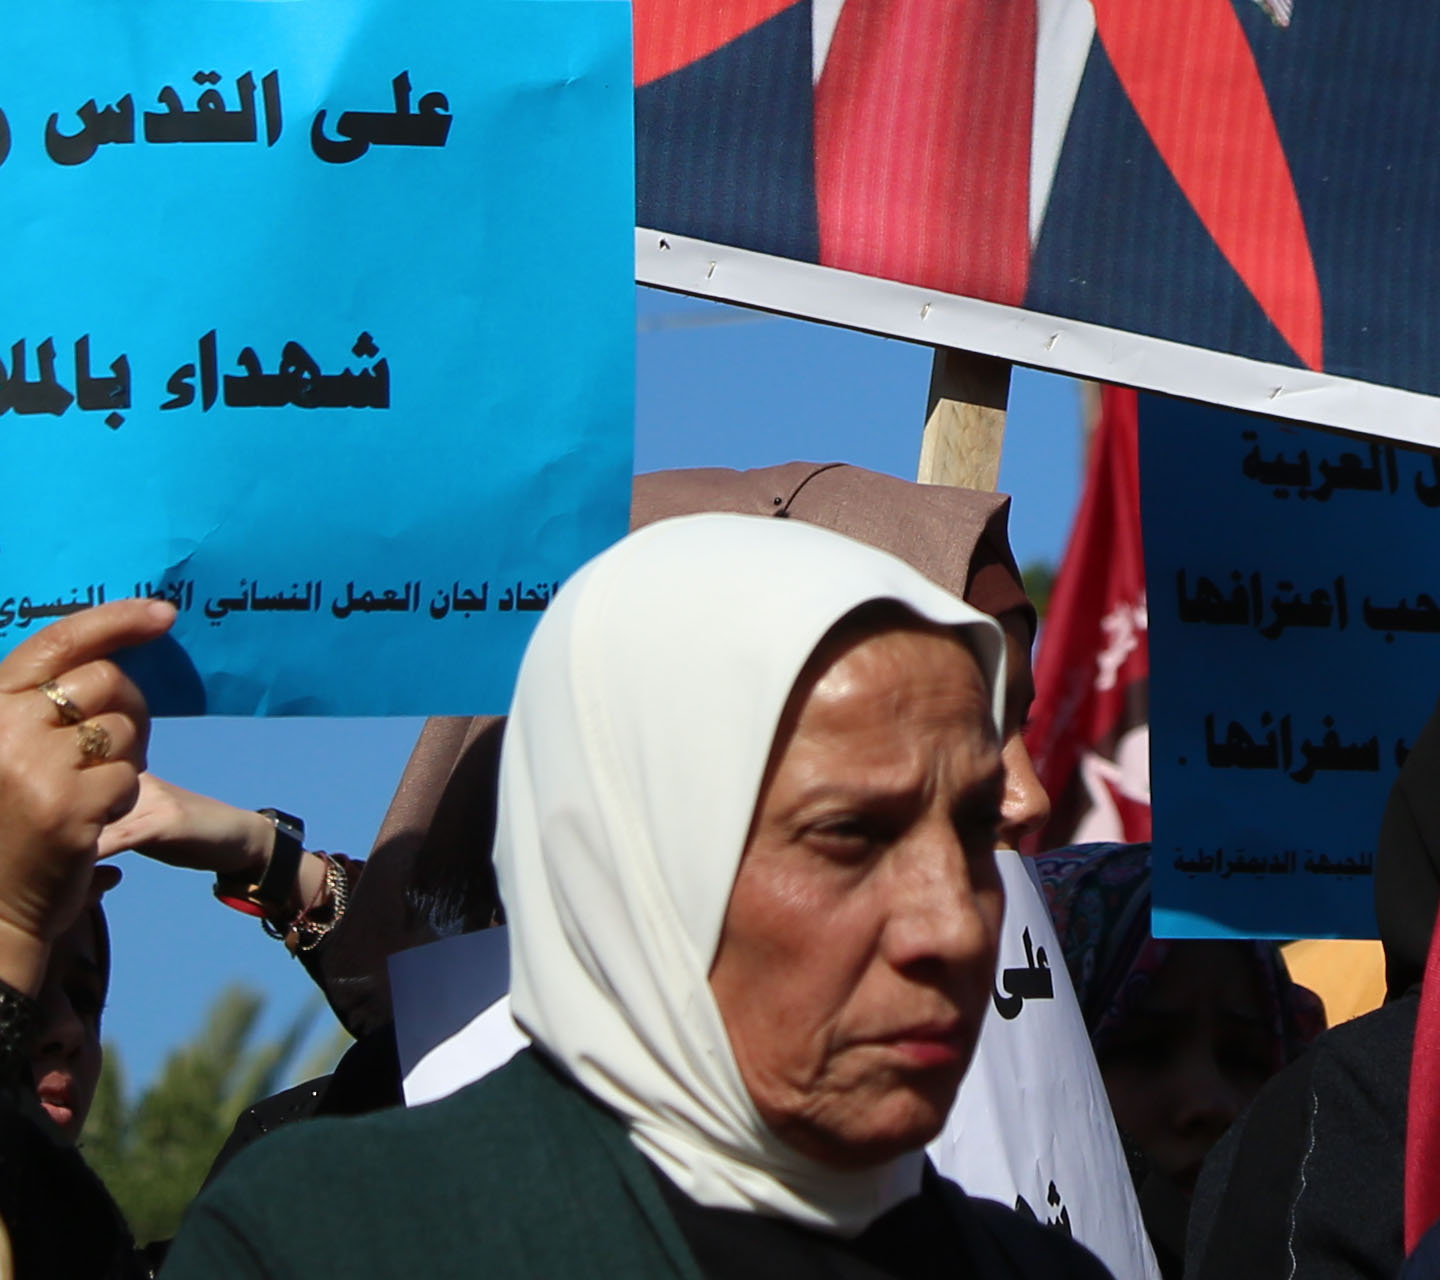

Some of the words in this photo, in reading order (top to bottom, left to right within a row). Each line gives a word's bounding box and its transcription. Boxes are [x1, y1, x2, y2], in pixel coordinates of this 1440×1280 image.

[43, 69, 282, 167] القدس
[309, 70, 454, 164] على
[161, 329, 391, 414] شهداء
[1242, 432, 1398, 502] العربية
[204, 578, 322, 627] النسائي
[331, 580, 421, 619] العمل
[429, 581, 489, 620] لجان
[1176, 568, 1348, 640] اعترافها
[992, 926, 1054, 1020] على
